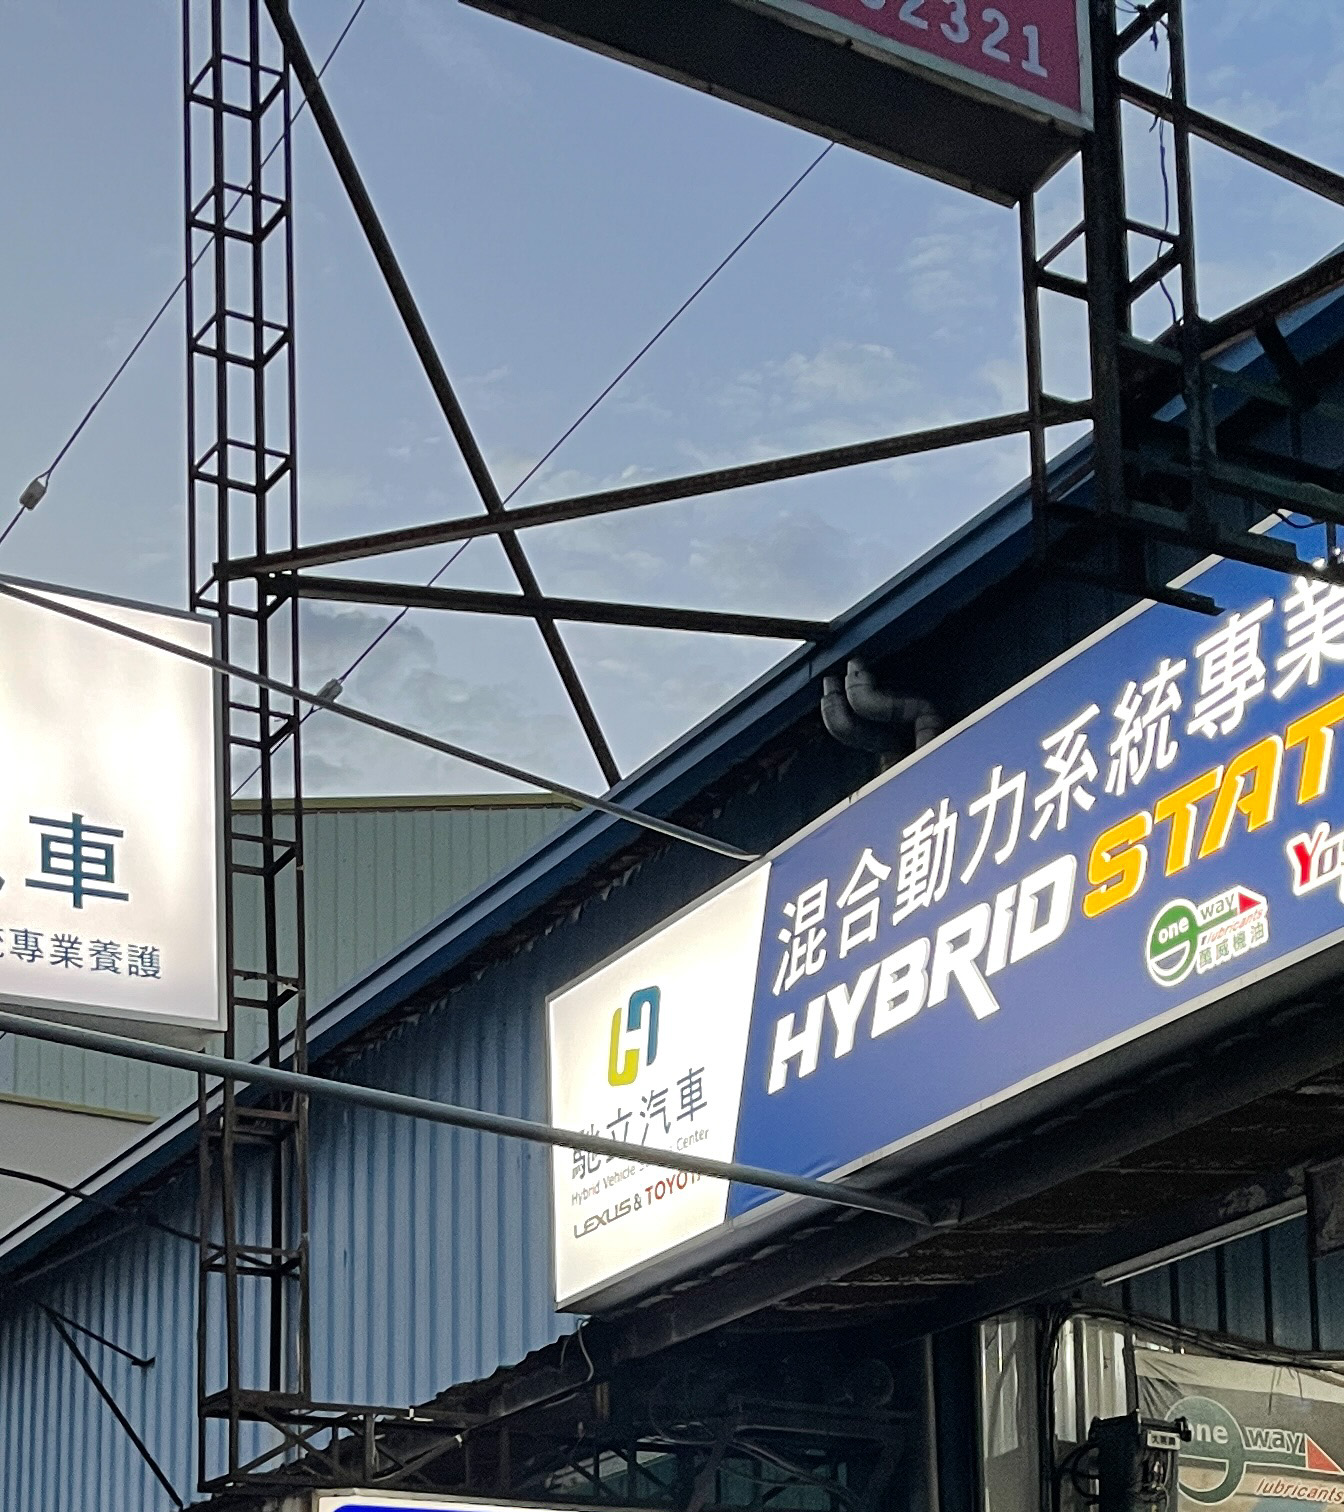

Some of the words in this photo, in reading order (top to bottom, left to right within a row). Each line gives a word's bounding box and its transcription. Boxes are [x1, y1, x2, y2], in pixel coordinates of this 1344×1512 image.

[865, 0, 1048, 78] 2321
[1158, 917, 1189, 944] one
[1200, 893, 1236, 921] way
[766, 853, 1078, 1095] HYBRID
[676, 1128, 709, 1152] Center
[573, 1197, 632, 1239] LEXUS
[633, 1193, 643, 1212] &
[1244, 1426, 1305, 1455] way
[1256, 1478, 1344, 1503] lubricants
